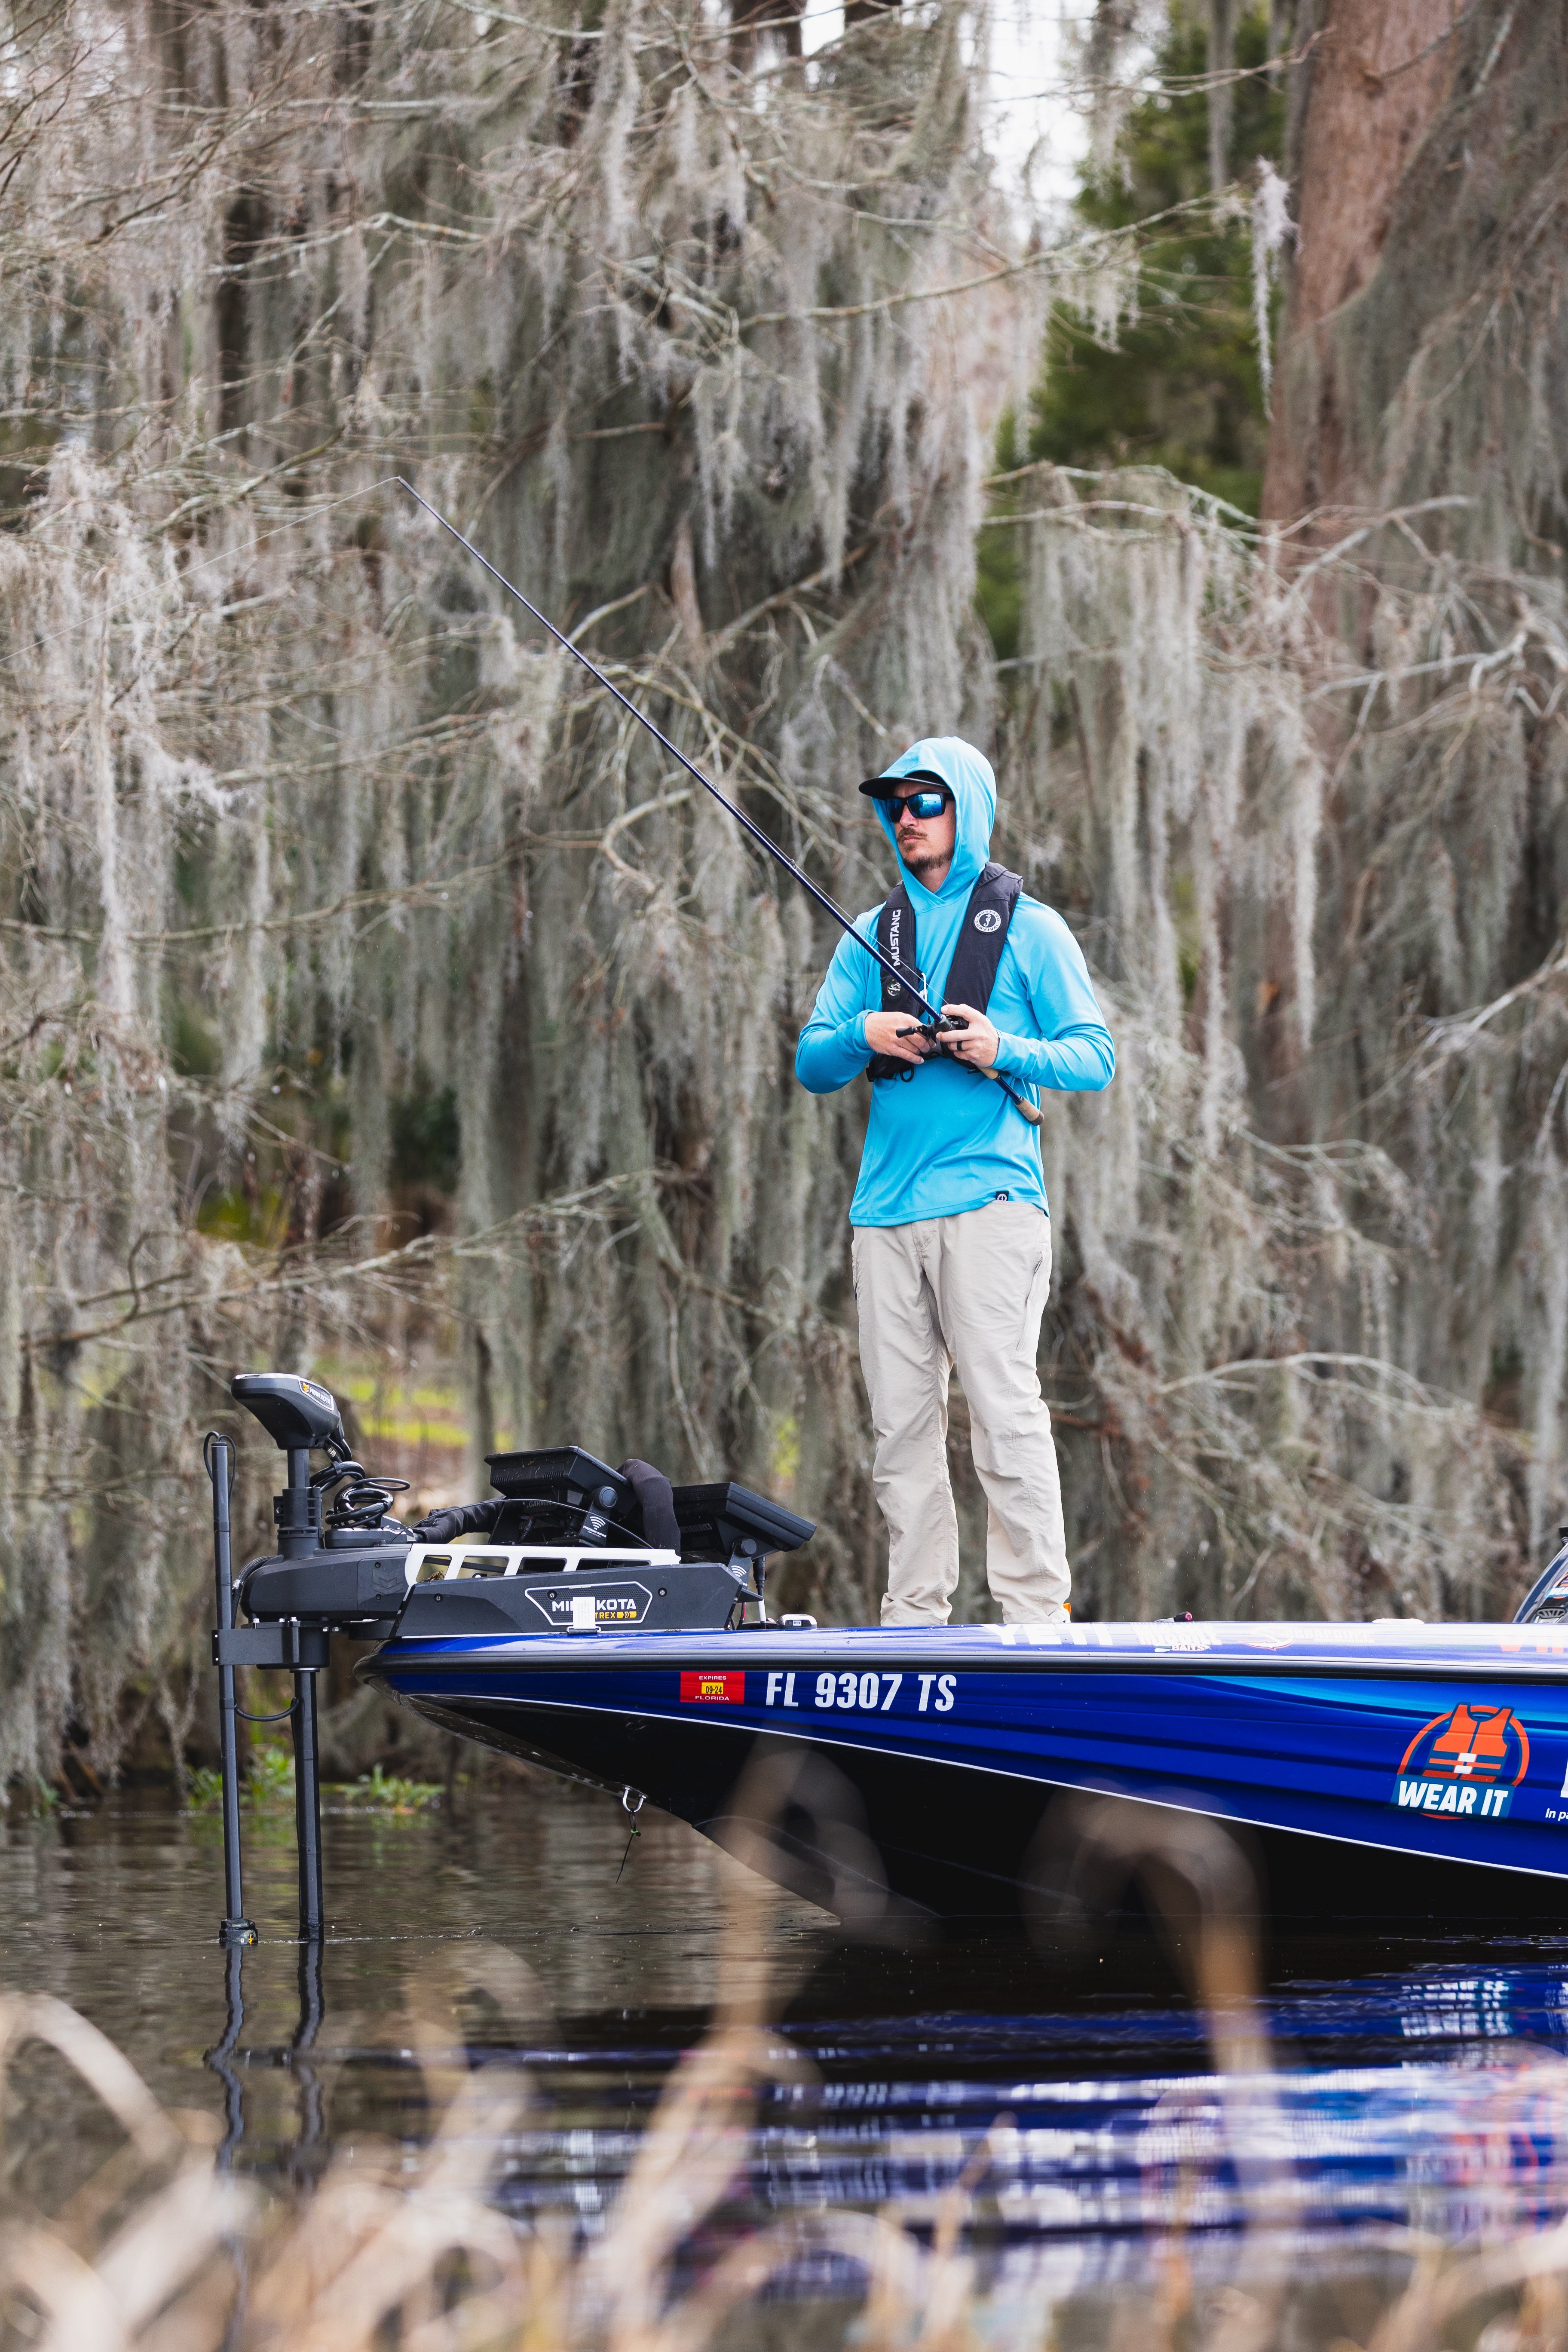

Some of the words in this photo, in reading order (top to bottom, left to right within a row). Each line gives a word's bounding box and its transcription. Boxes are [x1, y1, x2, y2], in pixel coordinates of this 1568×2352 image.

[977, 910, 1000, 922] MUSTANG
[975, 920, 999, 931] SURVIVAL
[890, 909, 901, 967] MUSTANG
[529, 1499, 552, 1507] GARMIN
[552, 1600, 573, 1612] MI
[596, 1599, 637, 1611] KOTA
[981, 1623, 1113, 1645] YETI
[705, 1686, 722, 1694] 09-24
[766, 1672, 799, 1707] FL
[815, 1672, 903, 1710] 9307
[918, 1674, 957, 1712] TS
[1398, 1780, 1477, 1814] WEAR
[1480, 1788, 1509, 1817] IT
[1545, 1808, 1556, 1818] In
